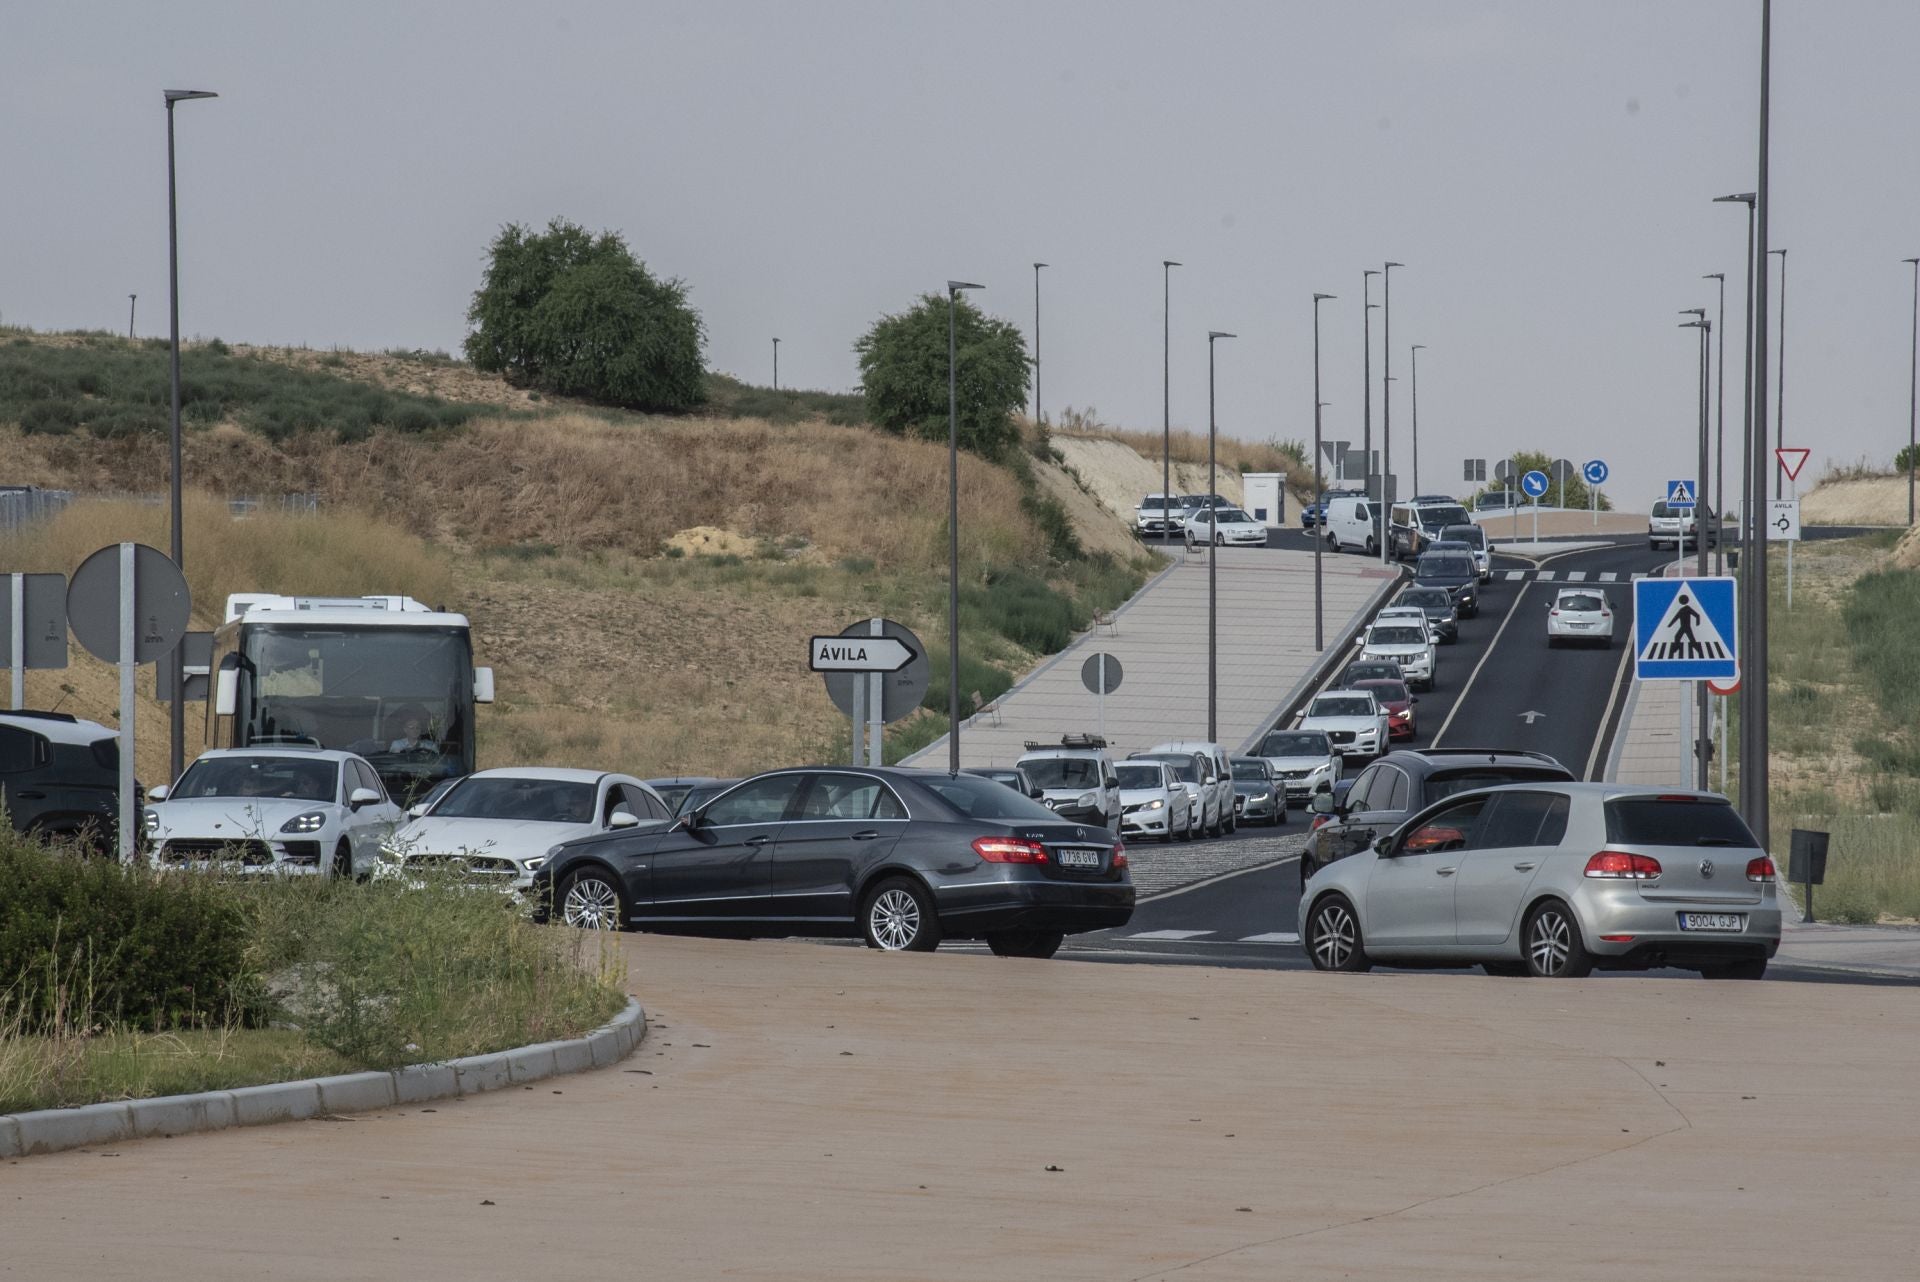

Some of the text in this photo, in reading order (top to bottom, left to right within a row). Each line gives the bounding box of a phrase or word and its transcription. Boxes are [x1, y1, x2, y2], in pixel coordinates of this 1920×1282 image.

[819, 644, 868, 661] ÁVILA
[1063, 850, 1097, 864] 1736 GVG
[1688, 914, 1737, 928] 9004 GJP
